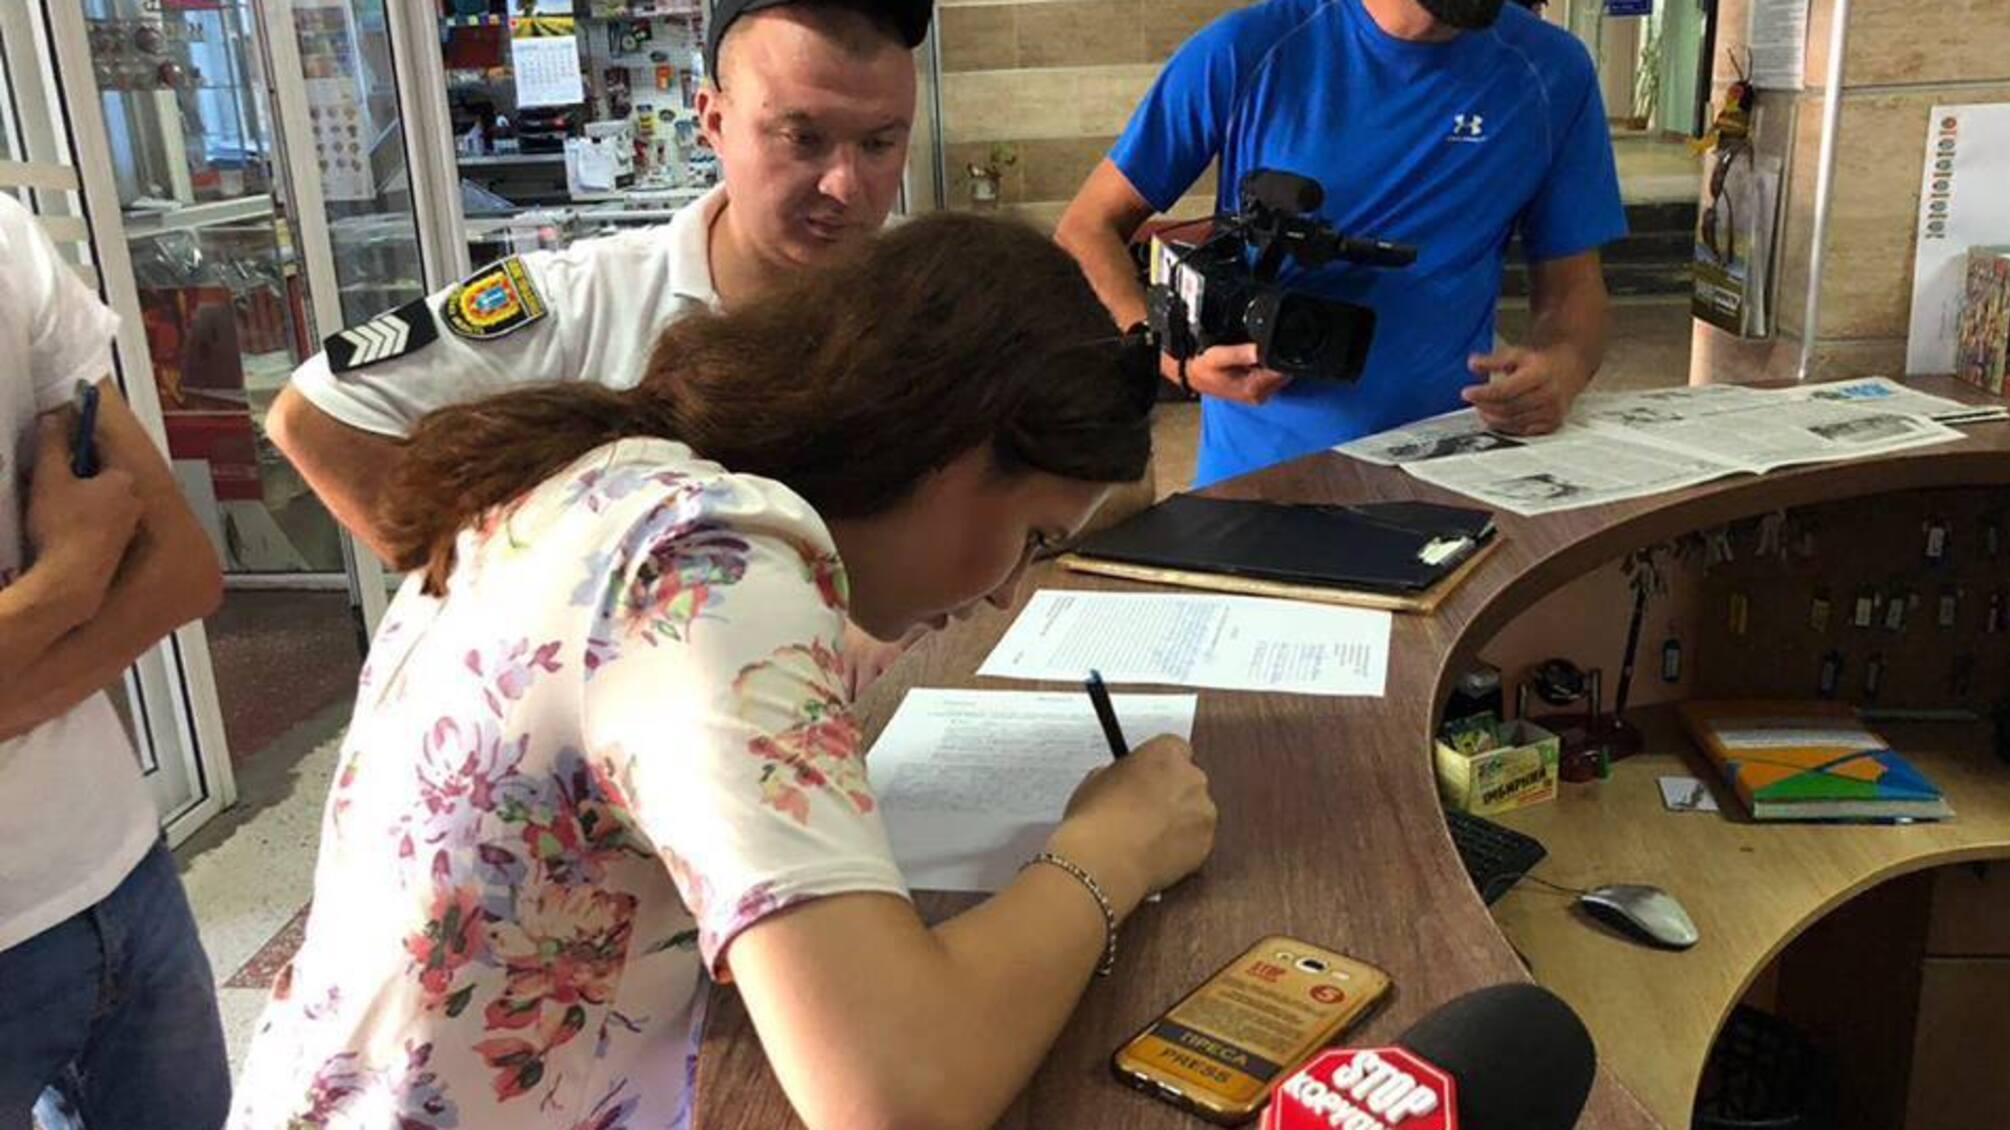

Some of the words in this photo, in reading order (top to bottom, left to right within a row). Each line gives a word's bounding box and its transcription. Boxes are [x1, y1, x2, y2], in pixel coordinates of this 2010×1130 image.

[1159, 1046, 1233, 1084] PRESS
[1181, 1031, 1248, 1067] ПРЕСА
[1282, 1071, 1388, 1130] КОРУП
[1332, 1050, 1438, 1124] STOP
